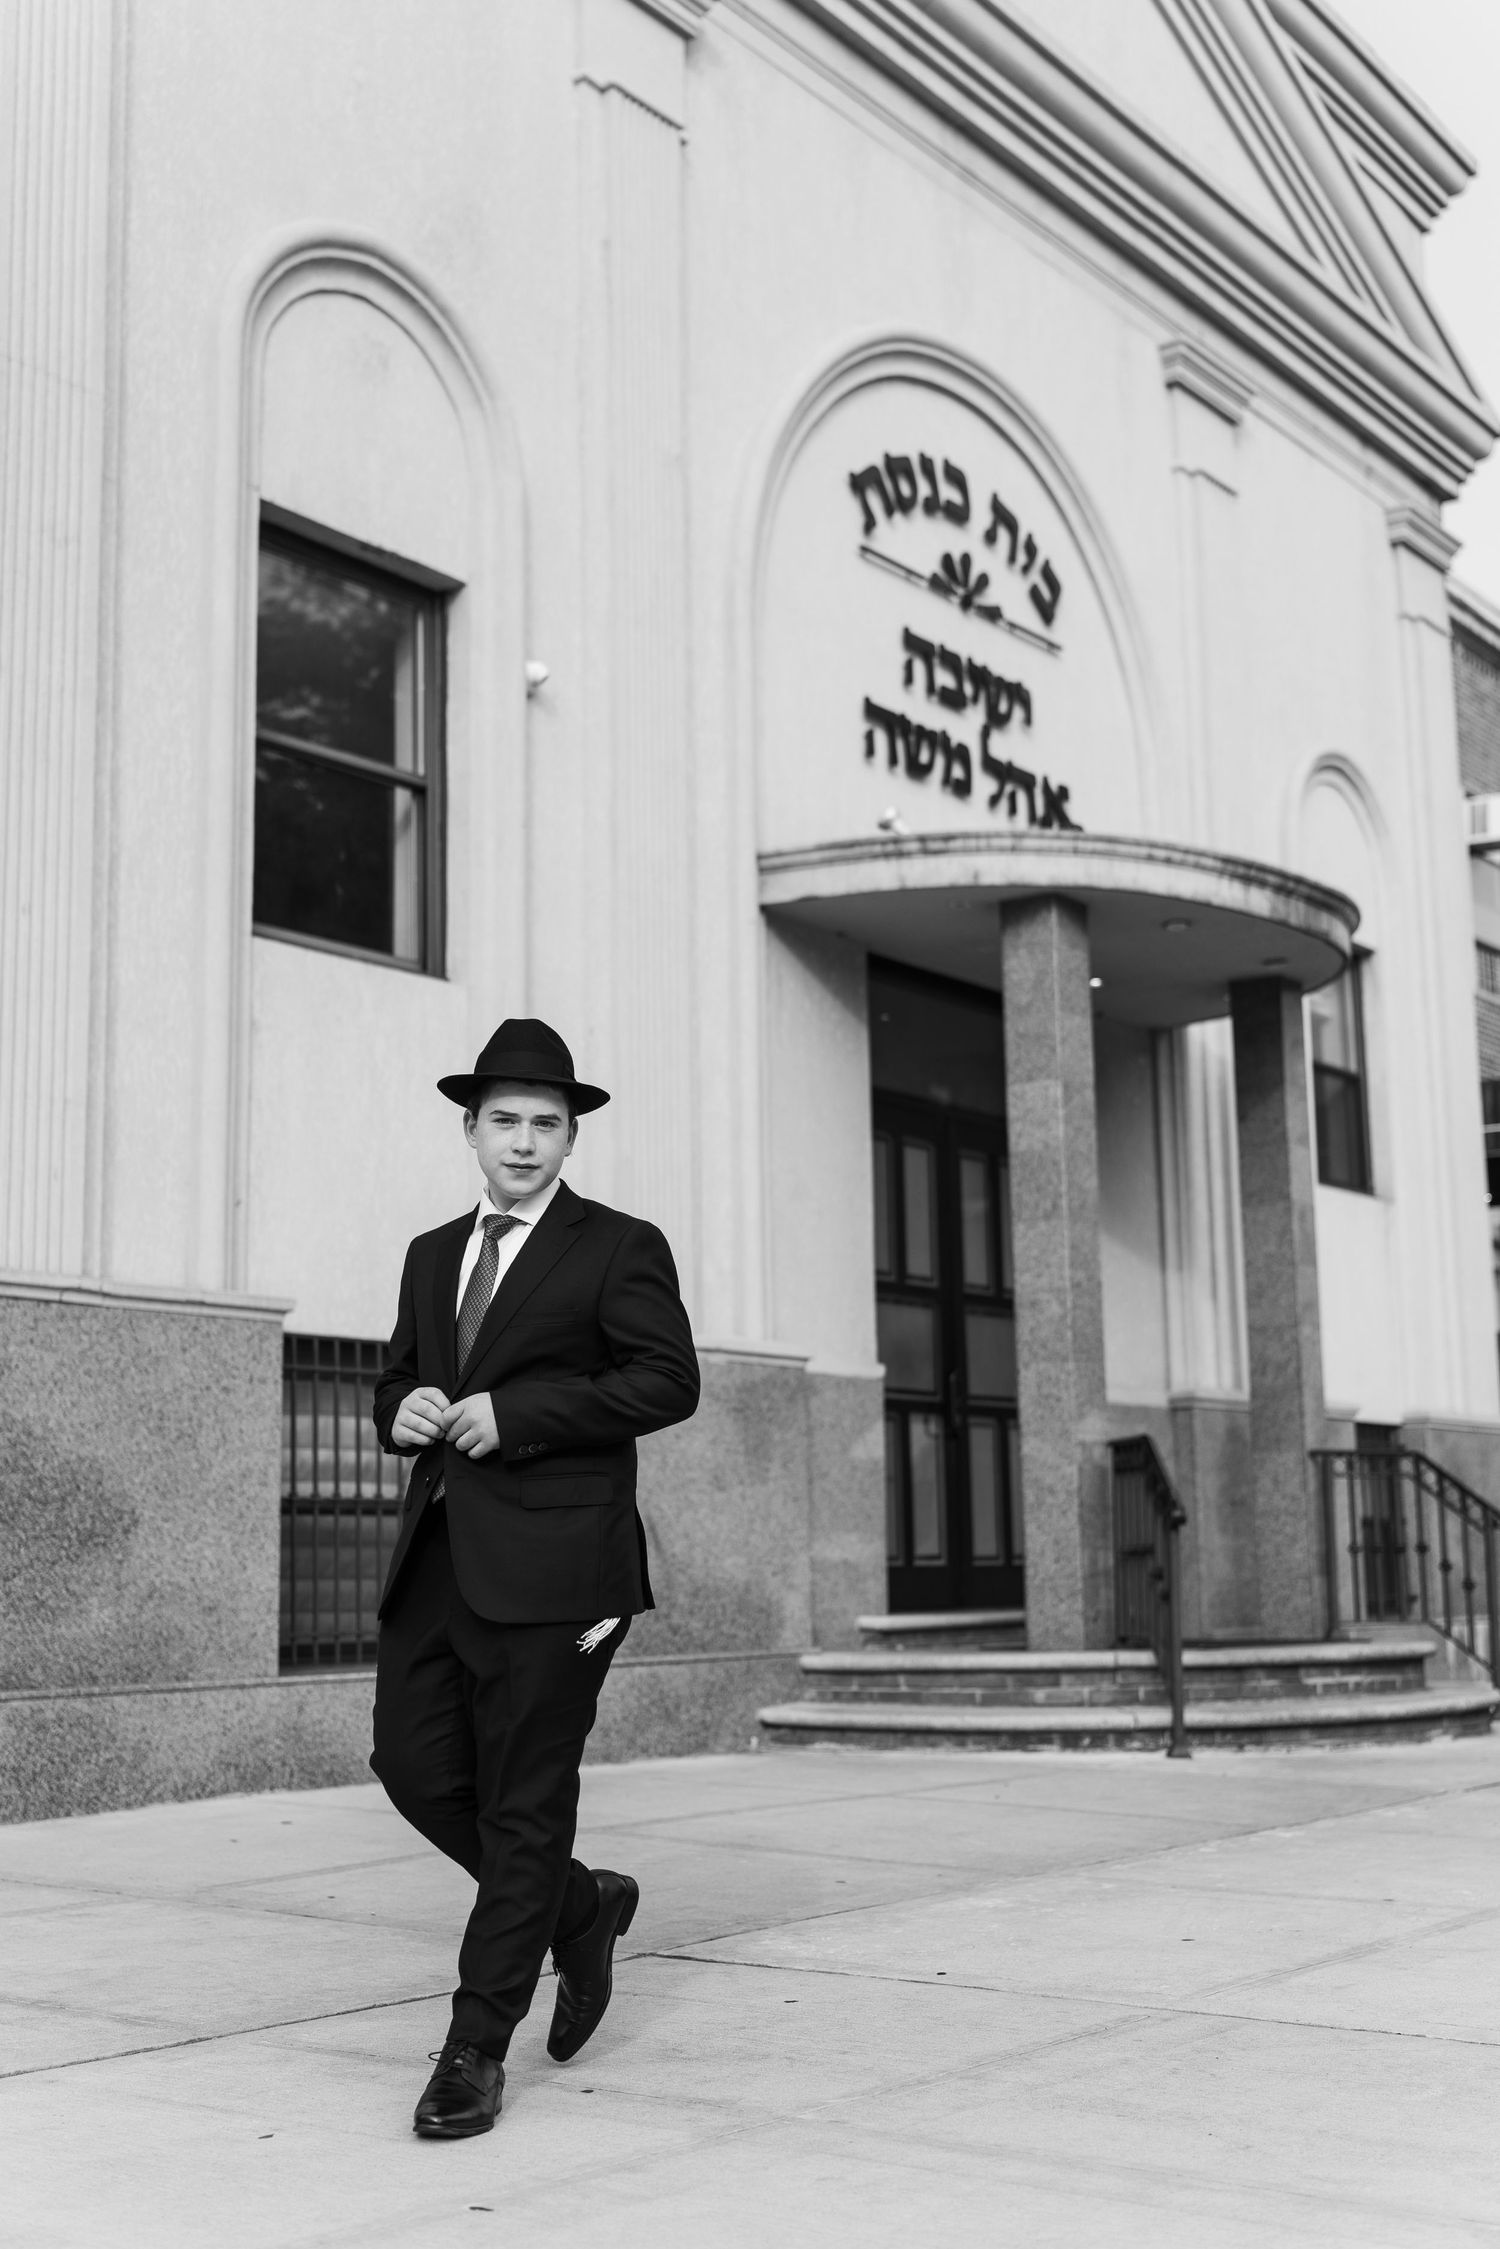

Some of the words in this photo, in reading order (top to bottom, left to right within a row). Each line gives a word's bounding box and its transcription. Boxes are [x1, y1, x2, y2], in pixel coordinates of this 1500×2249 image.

[848, 452, 971, 537] כנסת
[984, 492, 1062, 627] בית
[903, 626, 1032, 727] ישיבה
[864, 697, 972, 799] משה
[981, 723, 1083, 832] אהל
